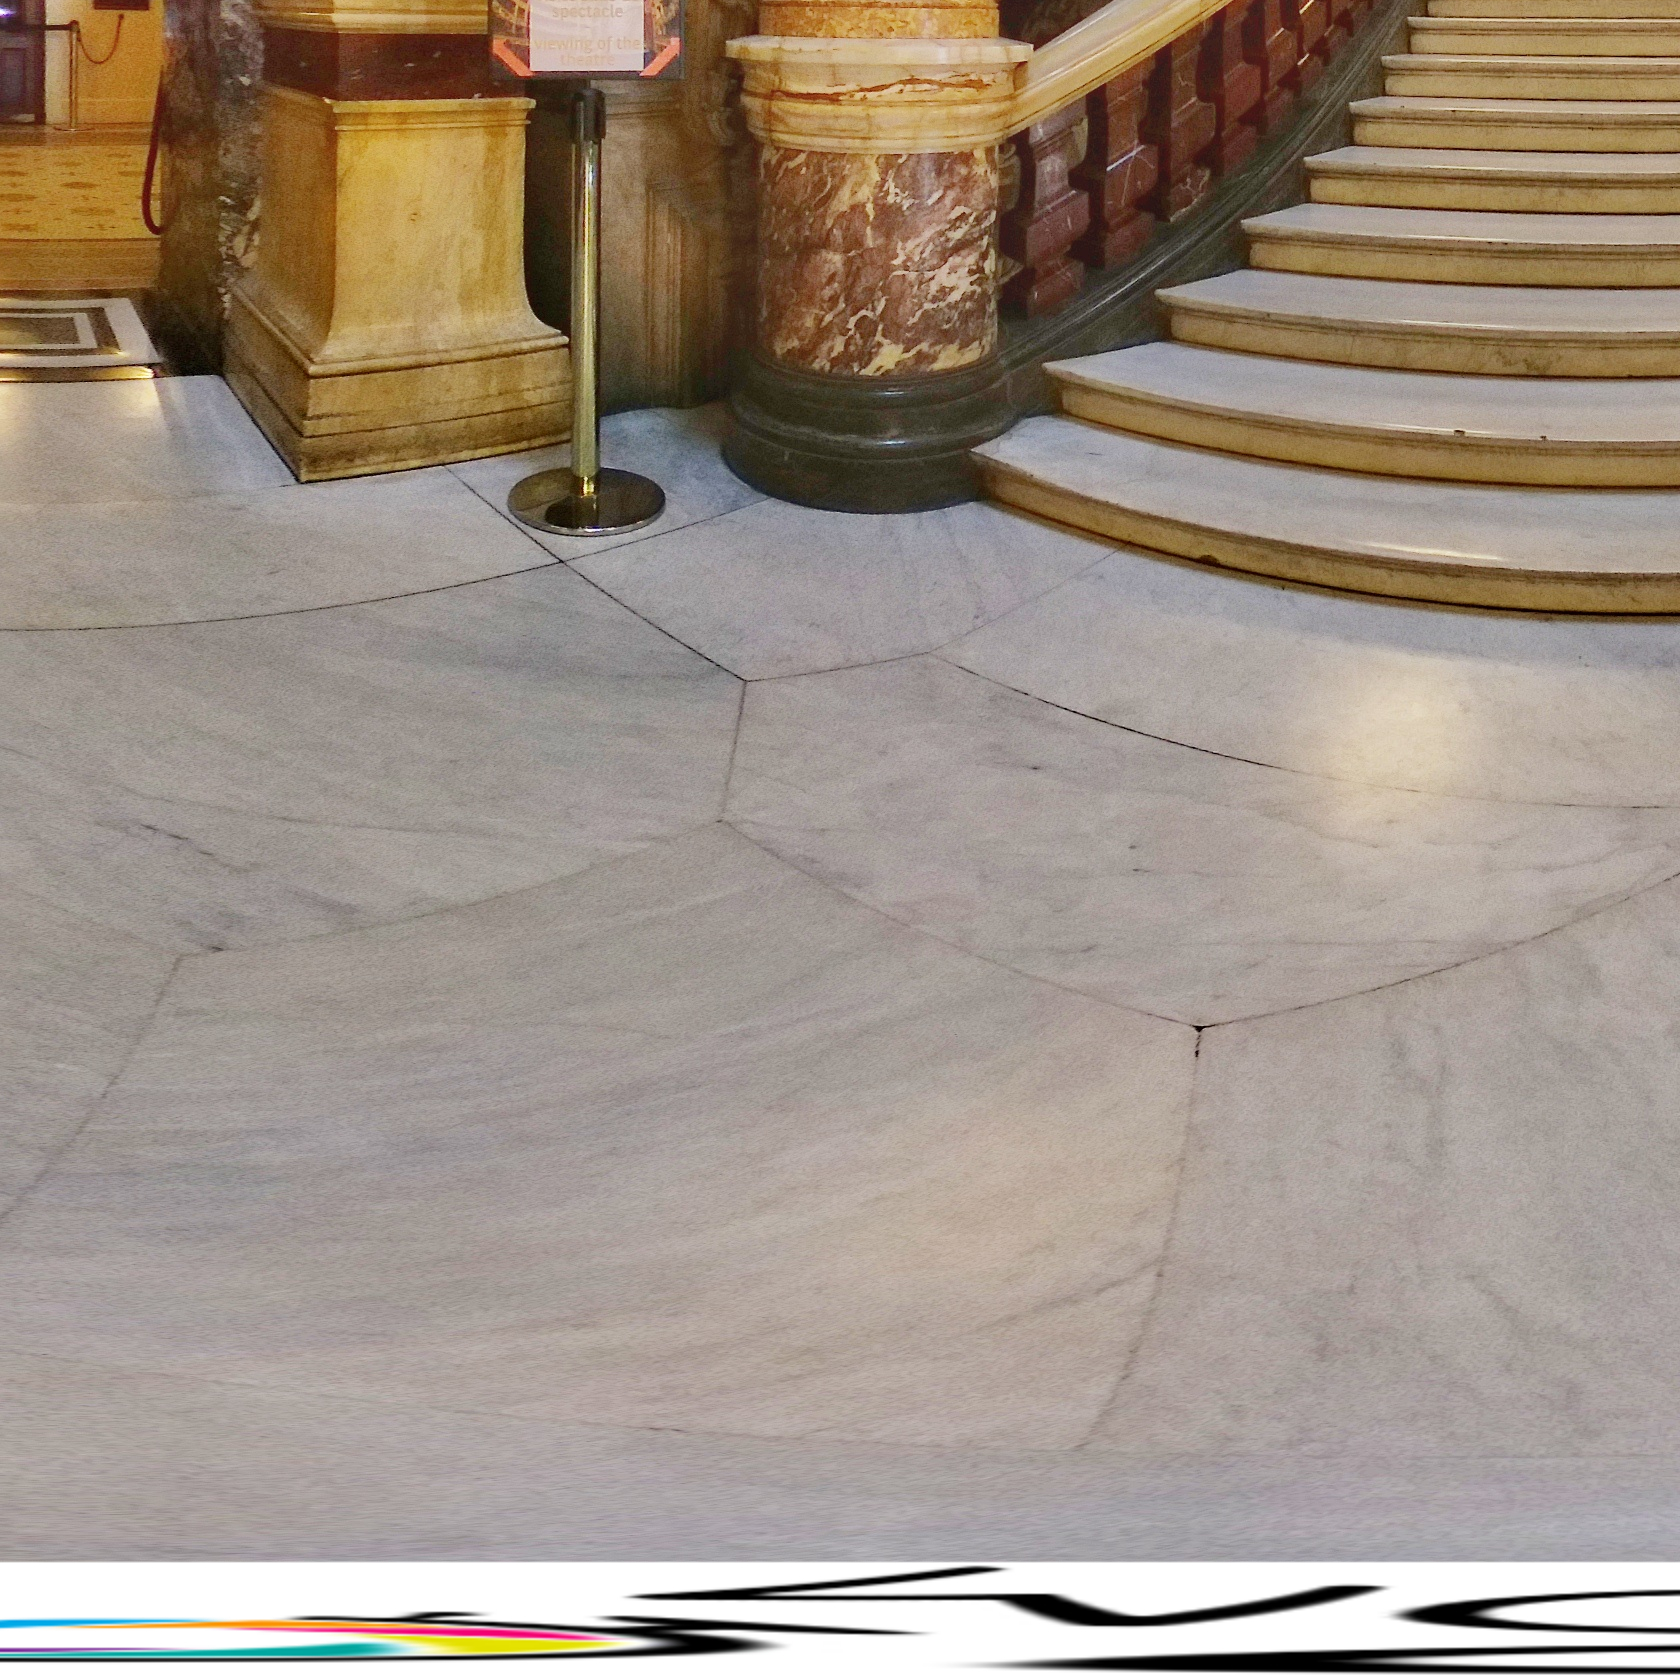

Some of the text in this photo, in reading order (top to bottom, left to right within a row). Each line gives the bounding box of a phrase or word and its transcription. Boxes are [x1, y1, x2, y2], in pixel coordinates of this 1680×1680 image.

[552, 4, 624, 21] spectacle
[534, 36, 641, 53] viewing of the
[560, 53, 616, 66] theatre
